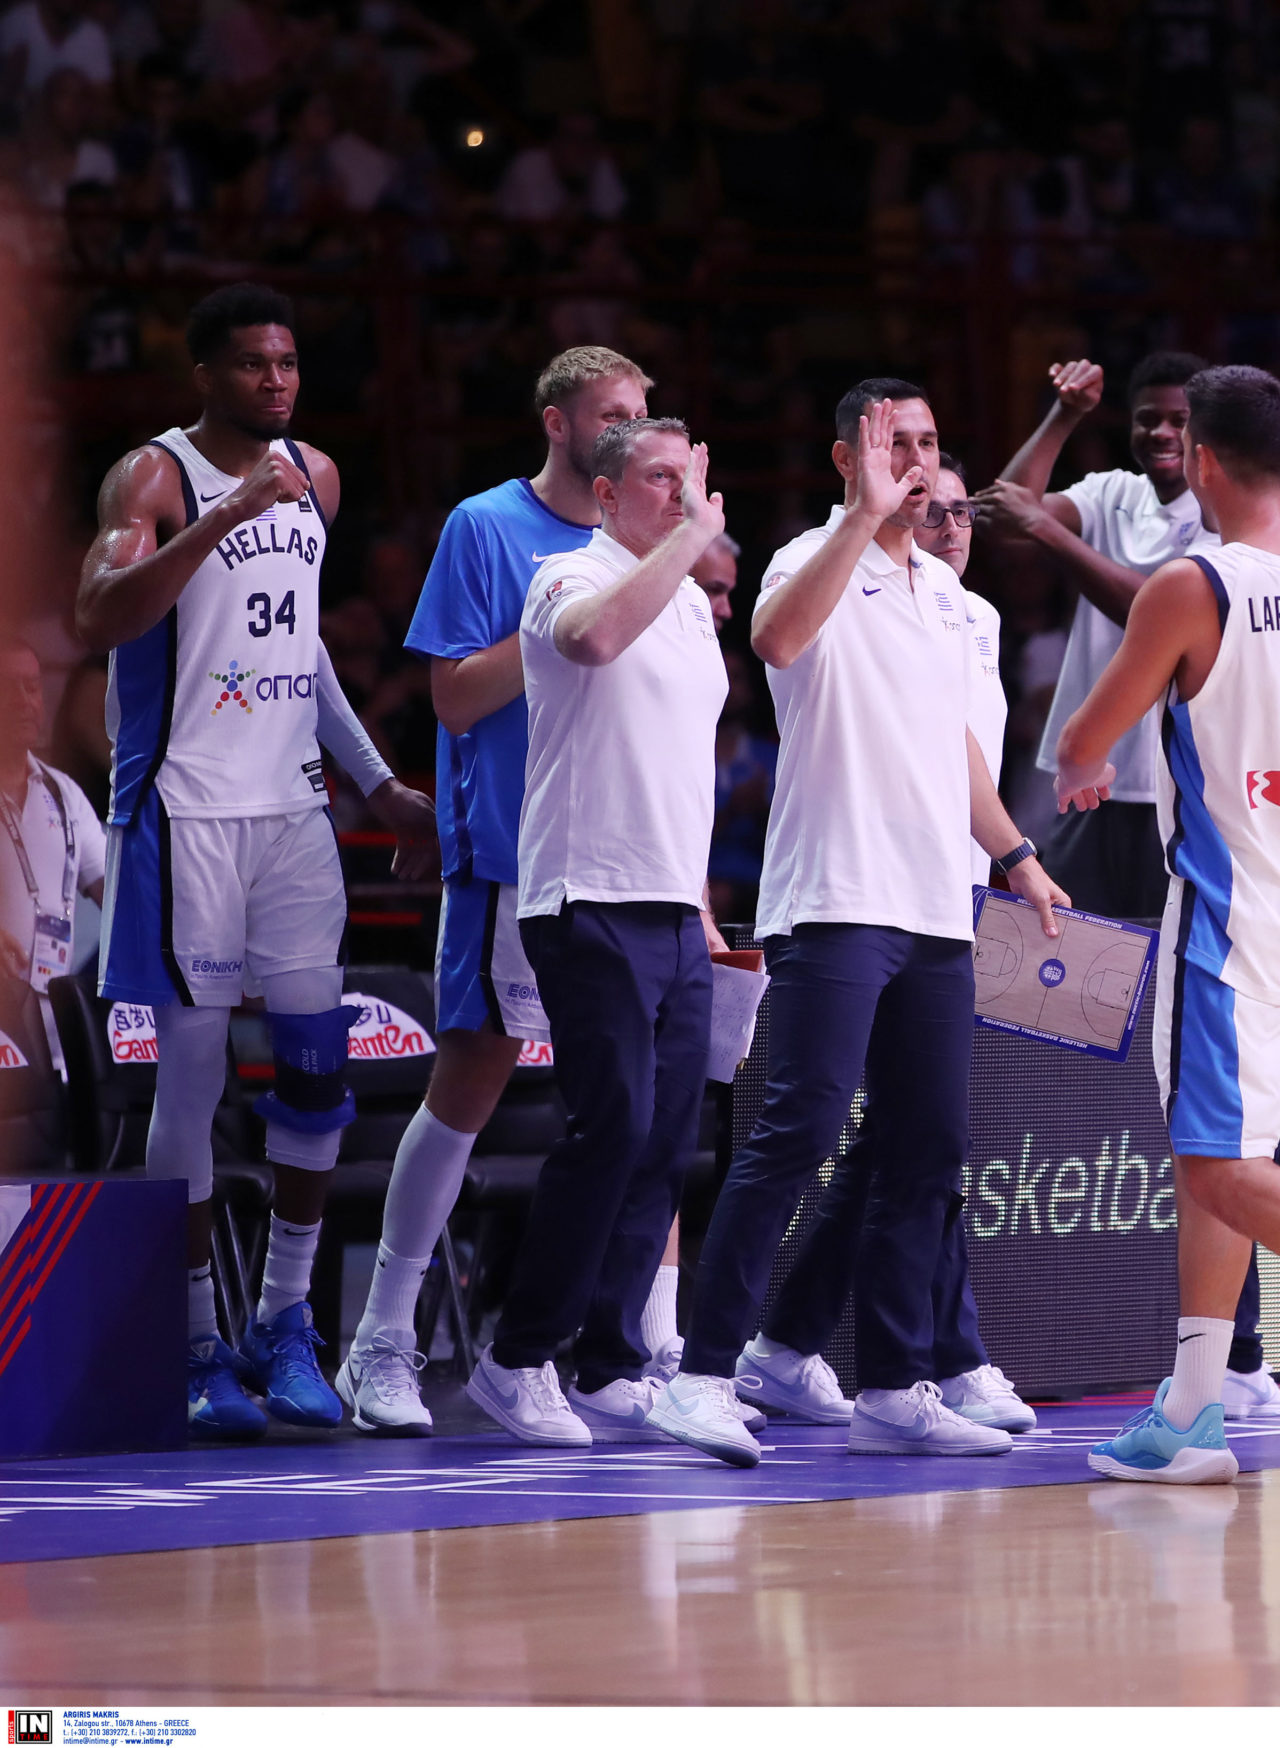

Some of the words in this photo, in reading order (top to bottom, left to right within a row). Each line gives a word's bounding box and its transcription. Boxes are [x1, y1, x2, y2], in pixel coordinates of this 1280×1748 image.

[216, 523, 318, 570] HELLAS
[247, 590, 296, 638] 34
[1084, 915, 1123, 929] FEDERATION
[982, 1017, 1020, 1031] FEDERATION
[348, 1025, 425, 1057] anten
[1020, 1027, 1059, 1041] BASKETBALL
[1059, 1037, 1088, 1049] HELLENIC
